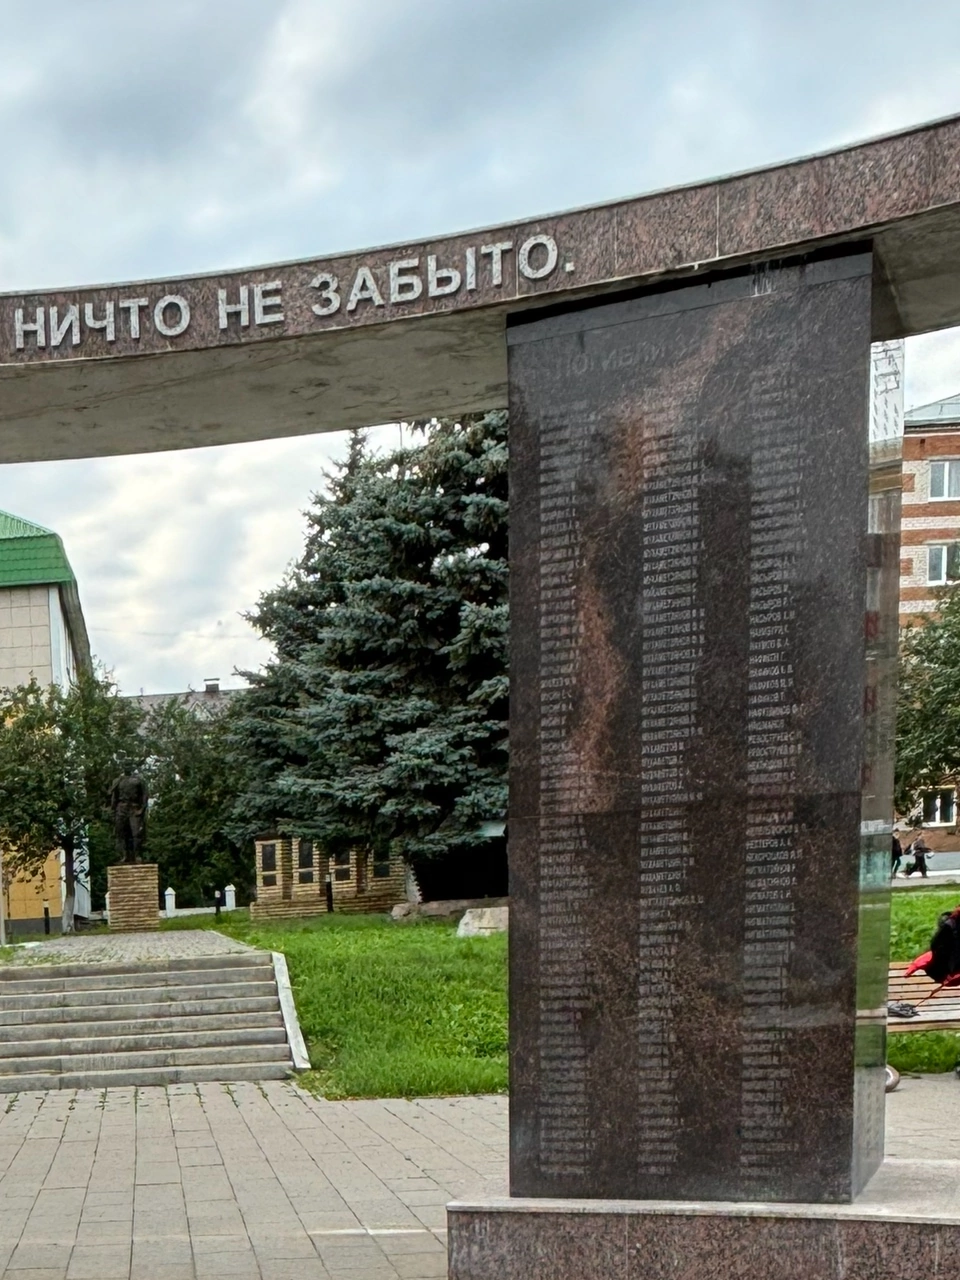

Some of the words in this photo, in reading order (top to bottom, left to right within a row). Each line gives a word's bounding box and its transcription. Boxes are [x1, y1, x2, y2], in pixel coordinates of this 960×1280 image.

[14, 294, 191, 349] НИЧТО
[217, 280, 286, 330] НЕ
[310, 234, 576, 316] ЗАБЫТО.
